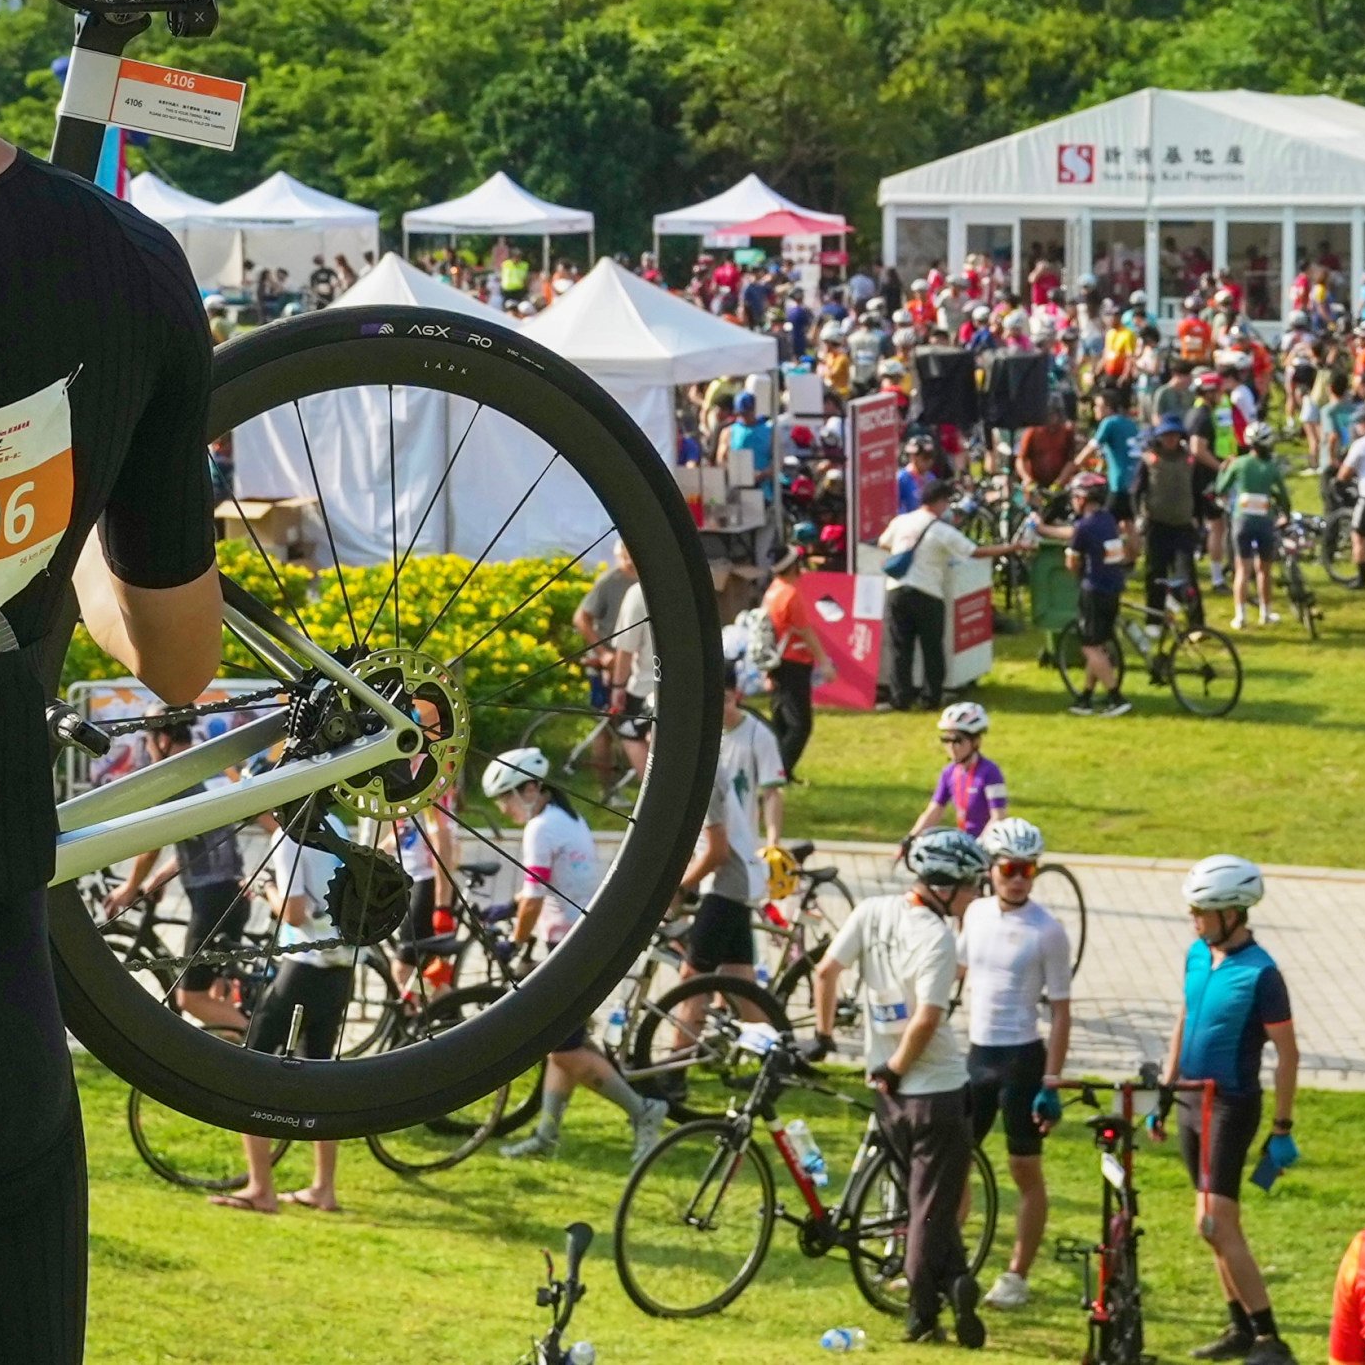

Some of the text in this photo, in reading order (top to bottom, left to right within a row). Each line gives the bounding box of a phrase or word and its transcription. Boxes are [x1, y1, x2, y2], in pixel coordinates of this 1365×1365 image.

[163, 72, 195, 89] 4106
[125, 97, 143, 108] 4106
[424, 361, 467, 375] LARK
[250, 1110, 301, 1128] Panaracer
